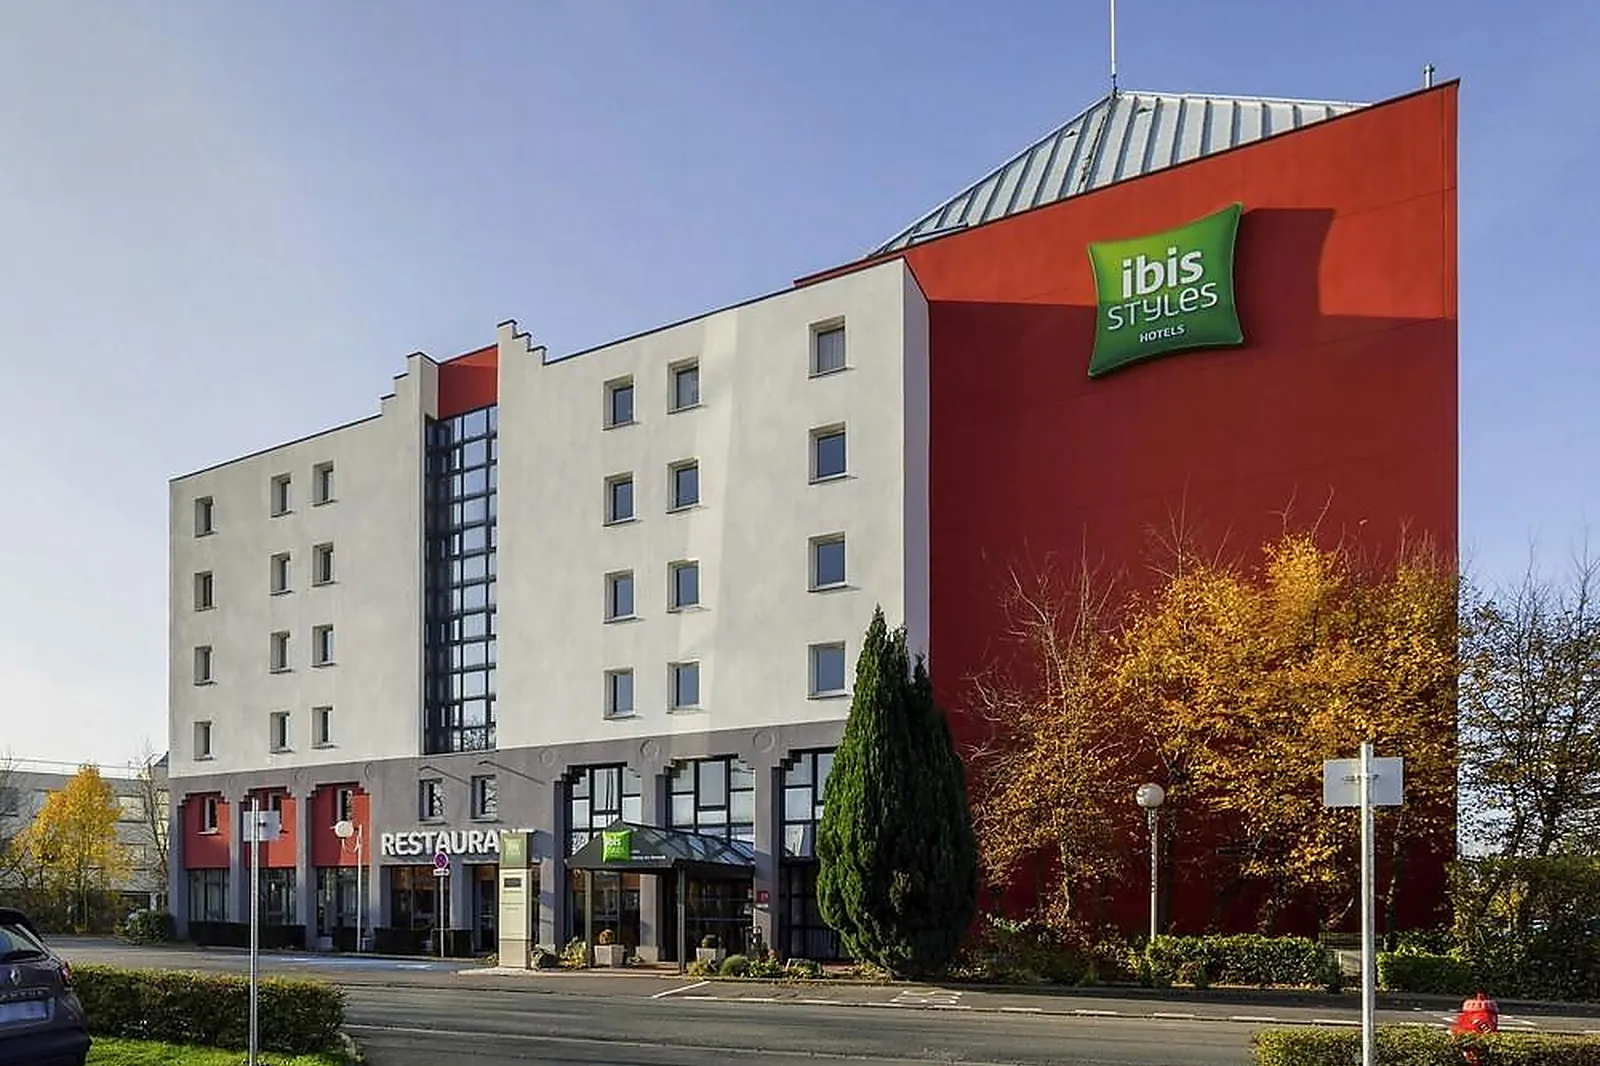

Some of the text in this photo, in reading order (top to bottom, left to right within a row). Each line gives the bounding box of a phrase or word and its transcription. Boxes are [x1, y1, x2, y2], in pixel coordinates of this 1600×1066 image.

[1122, 247, 1204, 299] ibis
[1140, 324, 1185, 343] HOTELS
[381, 828, 534, 856] RESTAURA
